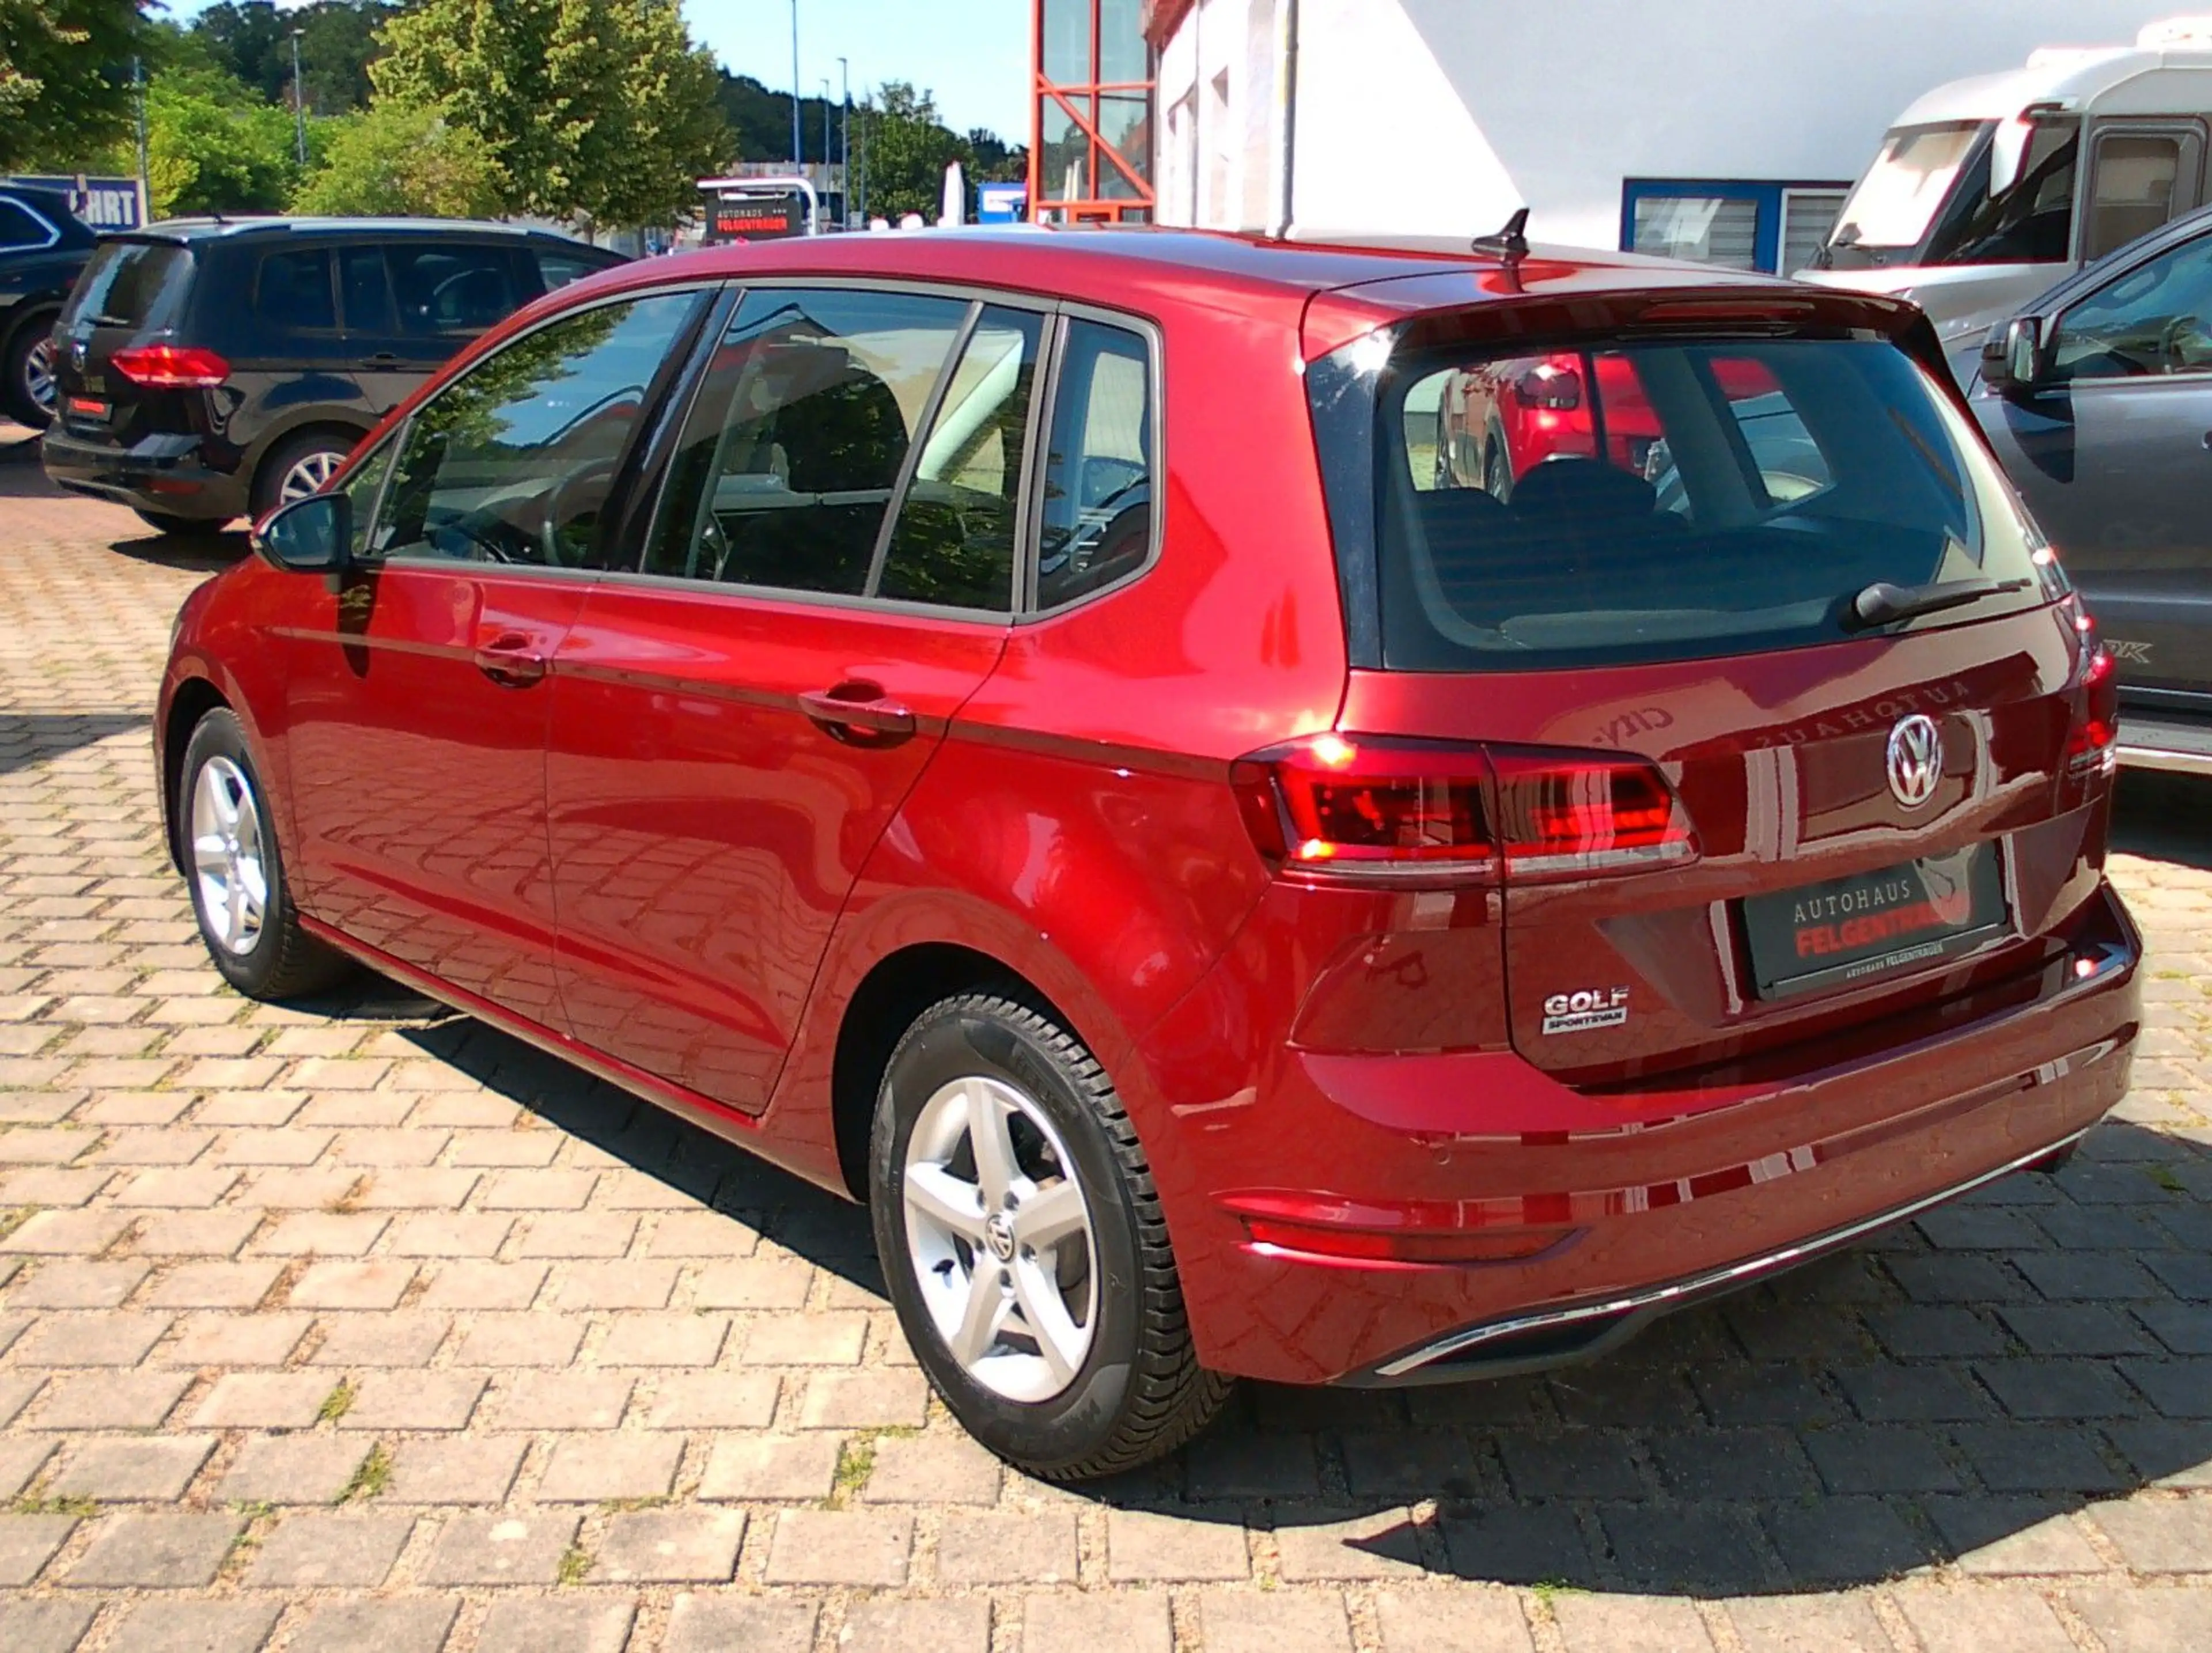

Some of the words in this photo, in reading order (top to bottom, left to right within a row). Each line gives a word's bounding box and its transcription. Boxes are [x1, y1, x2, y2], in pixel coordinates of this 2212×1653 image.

[1795, 880, 1912, 922] AUTOHAUS
[1544, 985, 1630, 1016] GOLF
[1548, 1011, 1623, 1029] SPORTSVAN
